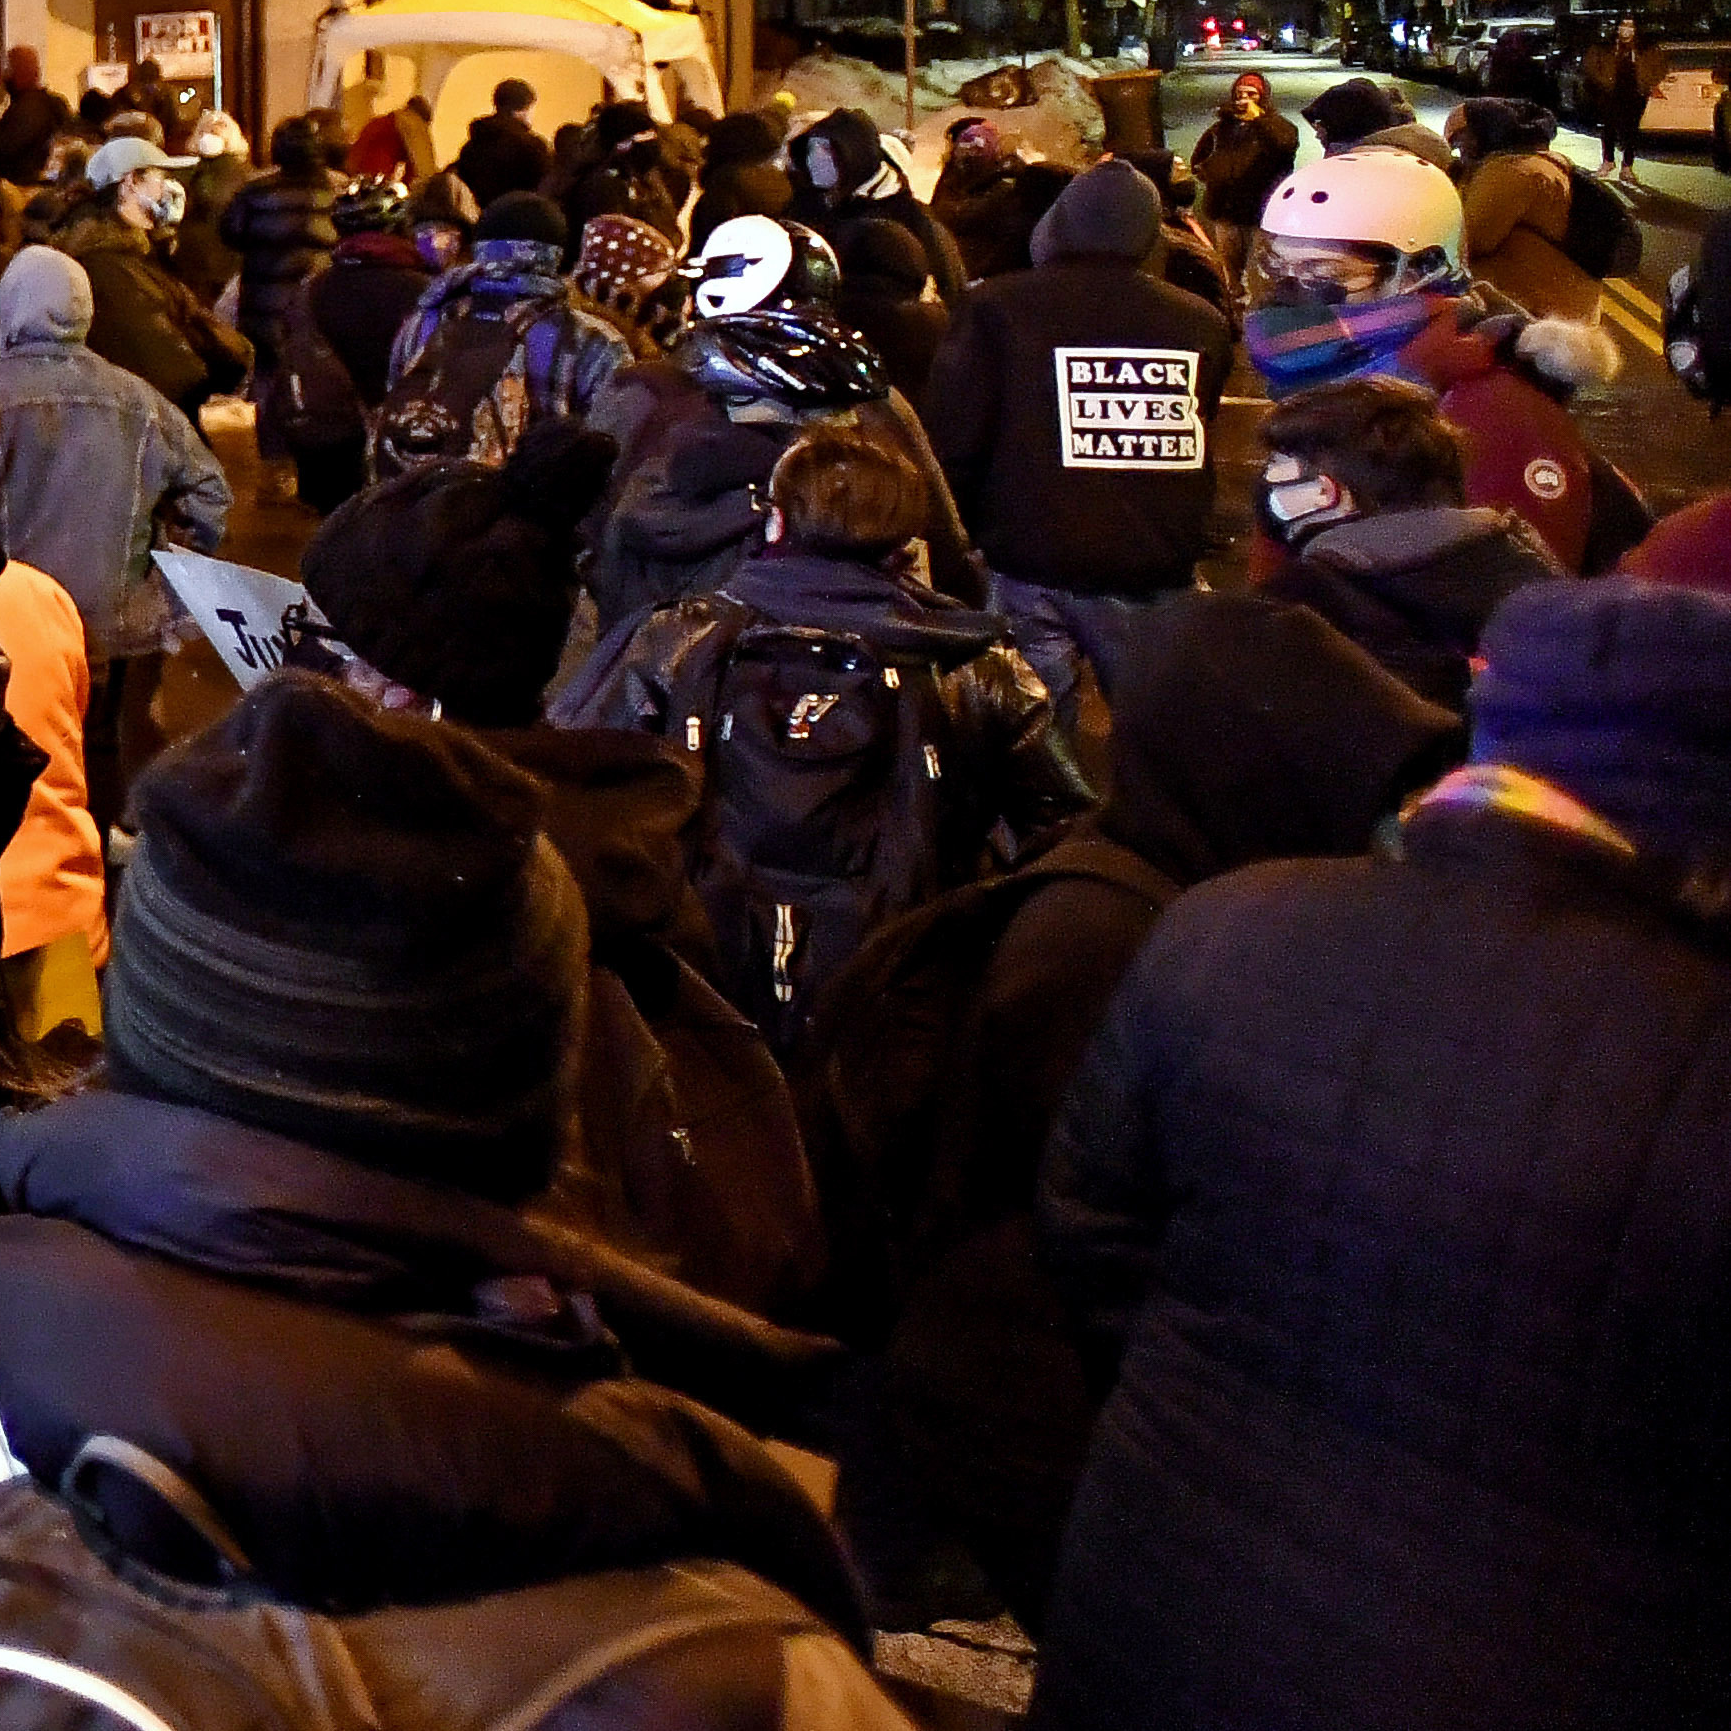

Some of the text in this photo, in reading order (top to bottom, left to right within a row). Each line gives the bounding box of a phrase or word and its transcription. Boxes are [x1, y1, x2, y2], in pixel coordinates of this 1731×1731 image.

[1070, 361, 1188, 386] BLACK
[1074, 398, 1187, 421] LIVES
[1071, 434, 1195, 457] MATTER
